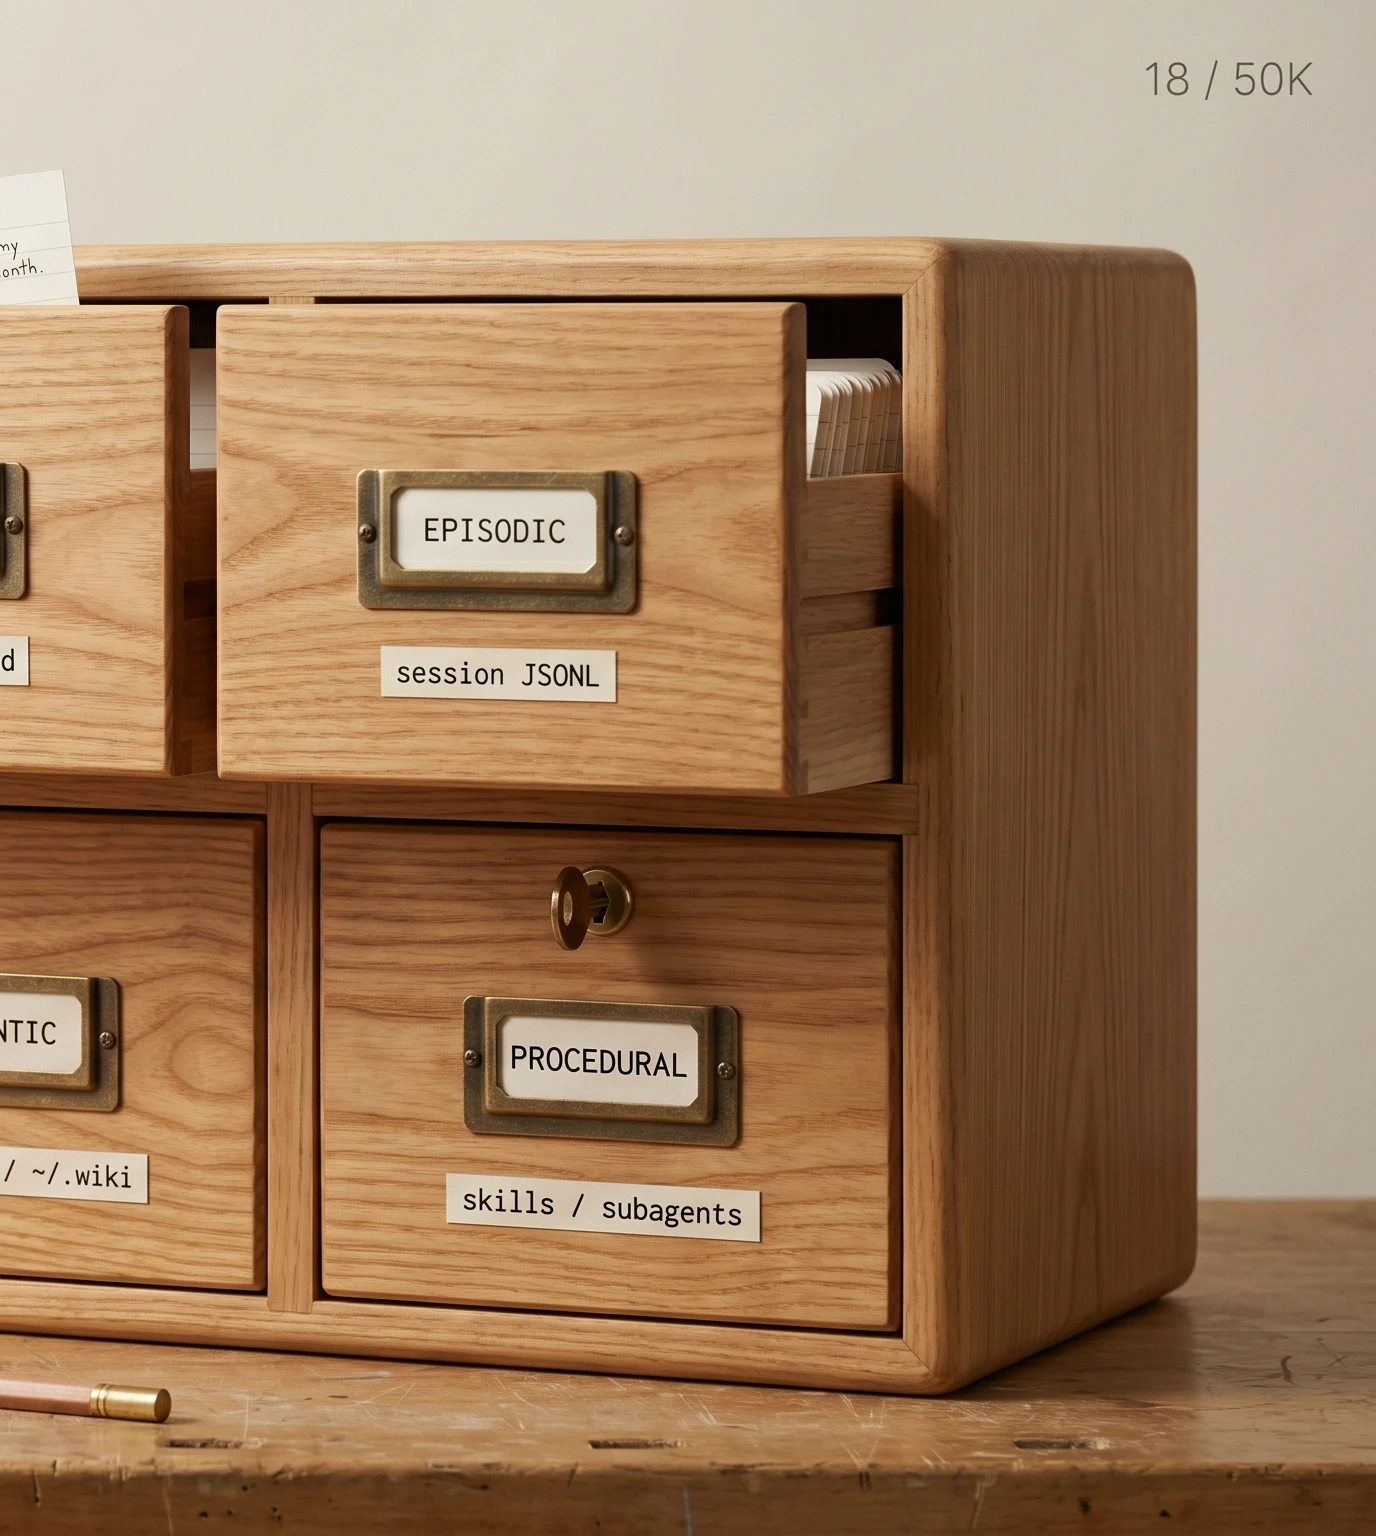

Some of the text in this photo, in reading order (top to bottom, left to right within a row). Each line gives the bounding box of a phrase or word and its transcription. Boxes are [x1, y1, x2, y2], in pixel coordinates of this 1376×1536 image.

[424, 517, 566, 544] EPISODIC
[397, 661, 600, 688] session JSONL
[511, 1044, 688, 1078] PROCEDURAL
[3, 1159, 16, 1183] /
[32, 1161, 132, 1189] ~/.wiki
[463, 1187, 742, 1228] skills / subagents
